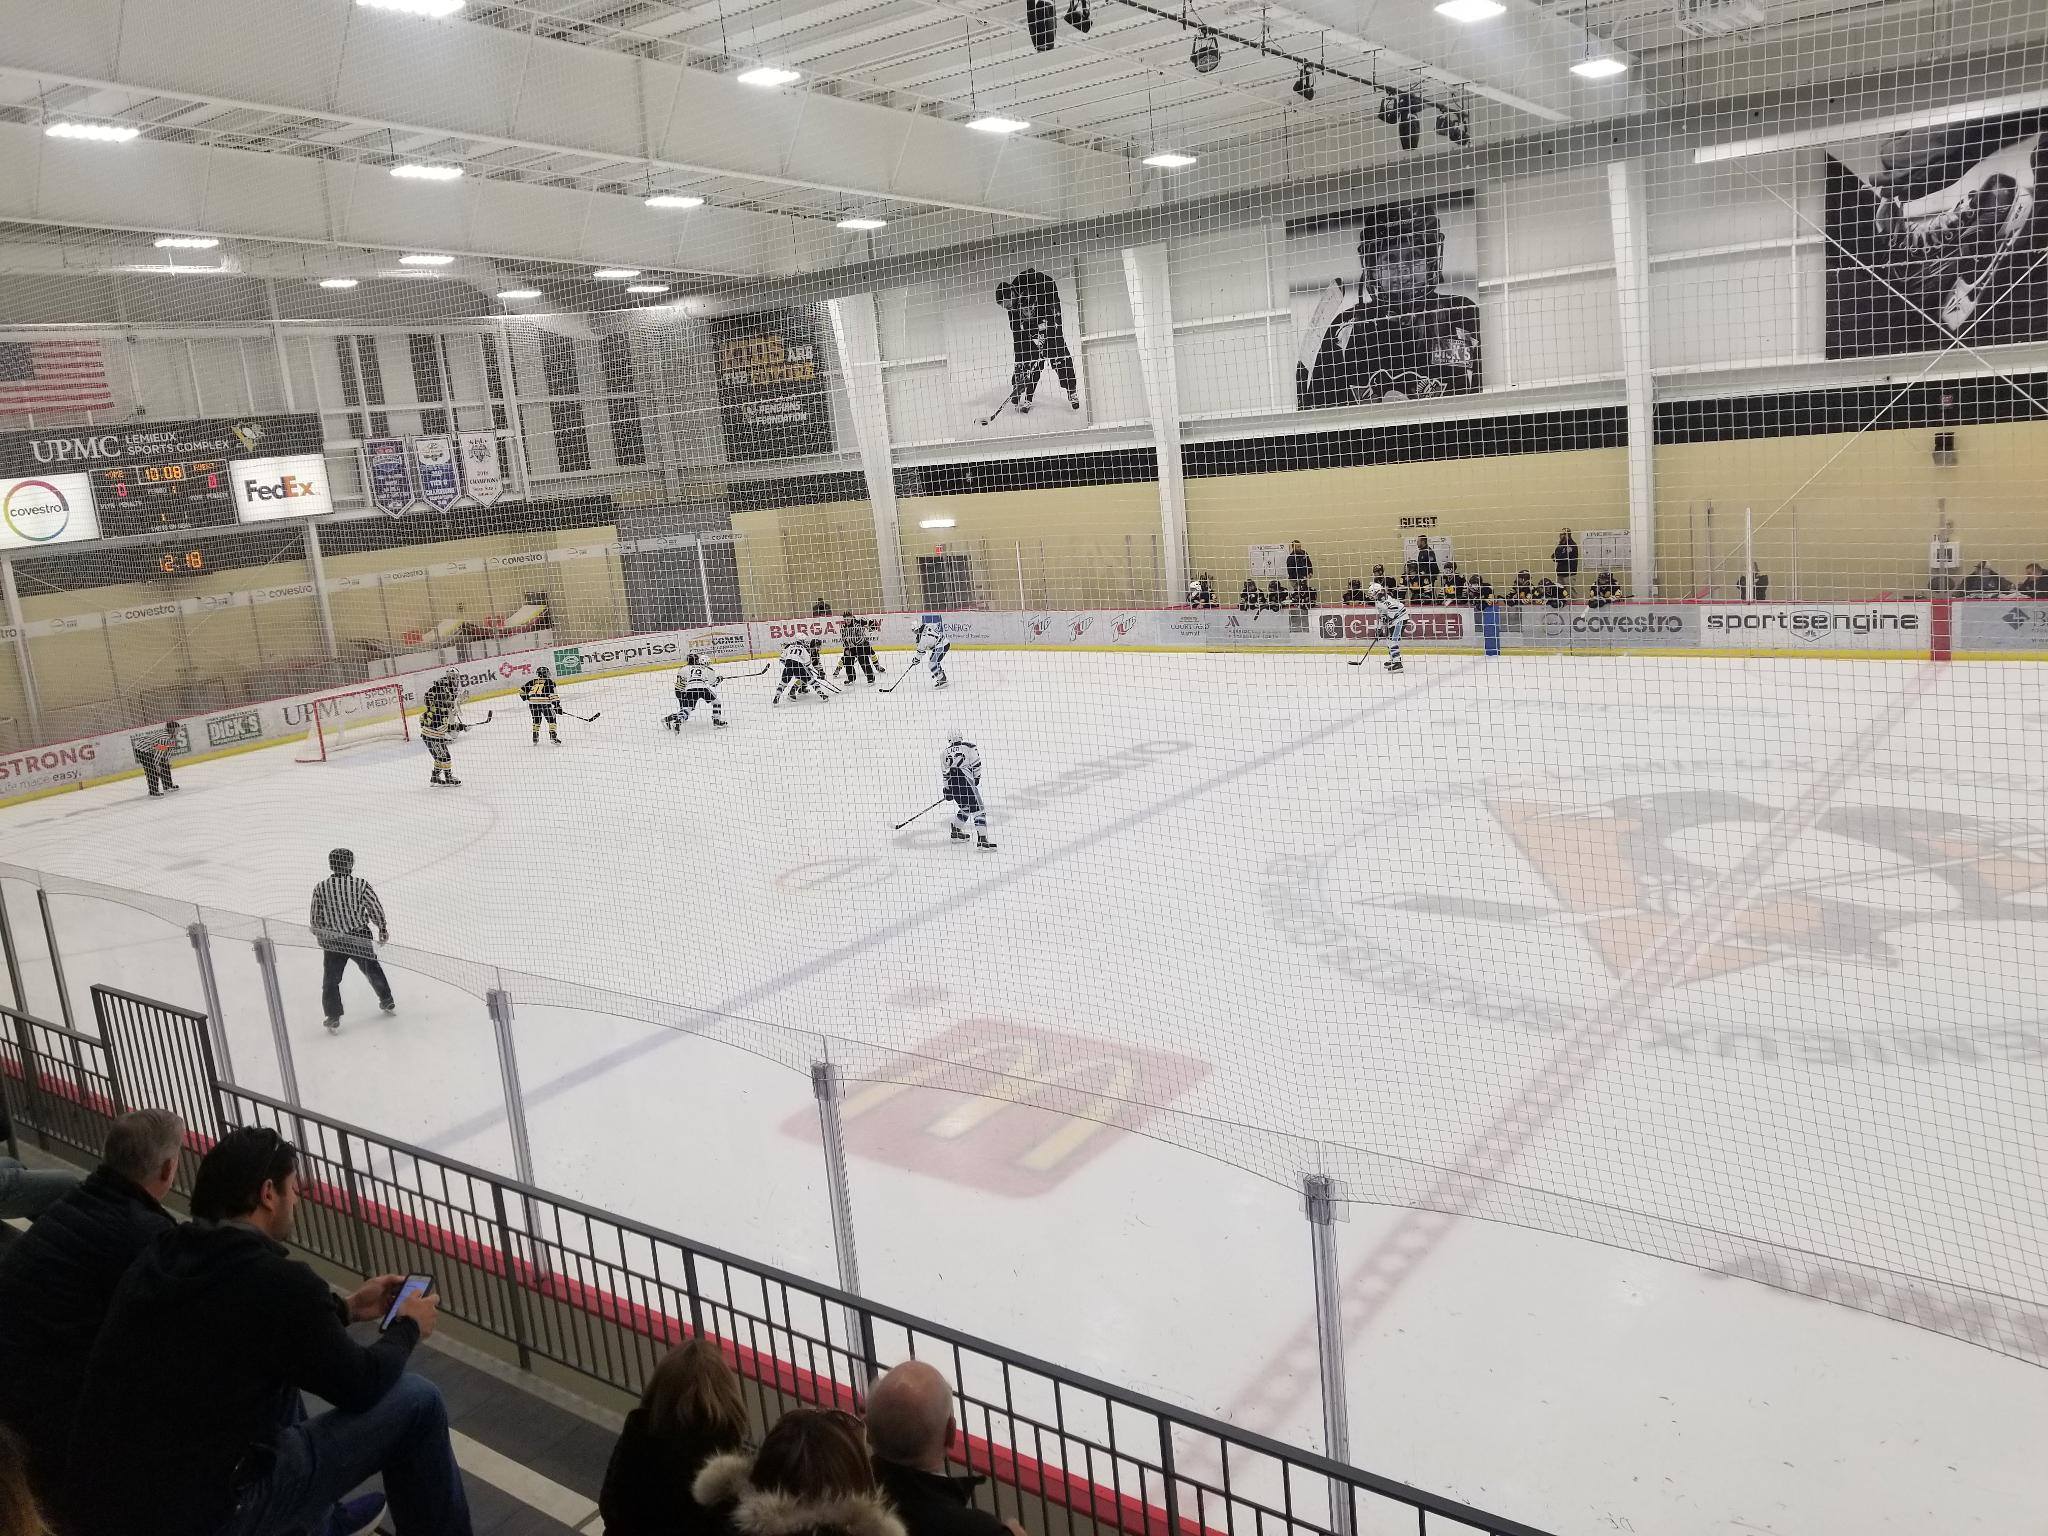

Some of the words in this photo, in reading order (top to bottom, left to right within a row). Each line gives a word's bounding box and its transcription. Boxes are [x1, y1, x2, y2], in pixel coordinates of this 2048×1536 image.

[125, 431, 177, 444] LEMIEUX
[29, 435, 121, 463] UPMC
[127, 442, 174, 456] SPORTS
[176, 439, 230, 453] COMPLEX
[244, 475, 321, 503] FedEx
[10, 502, 62, 518] covestro
[1400, 516, 1437, 528] GUEST
[502, 553, 543, 567] covestro
[269, 584, 313, 599] covestro
[125, 603, 176, 619] covestro
[1572, 613, 1683, 633] covestro
[1707, 609, 1920, 634] sportsengine
[208, 715, 260, 741] DICK'S
[0, 744, 96, 779] STRONG
[52, 769, 82, 782] easy.
